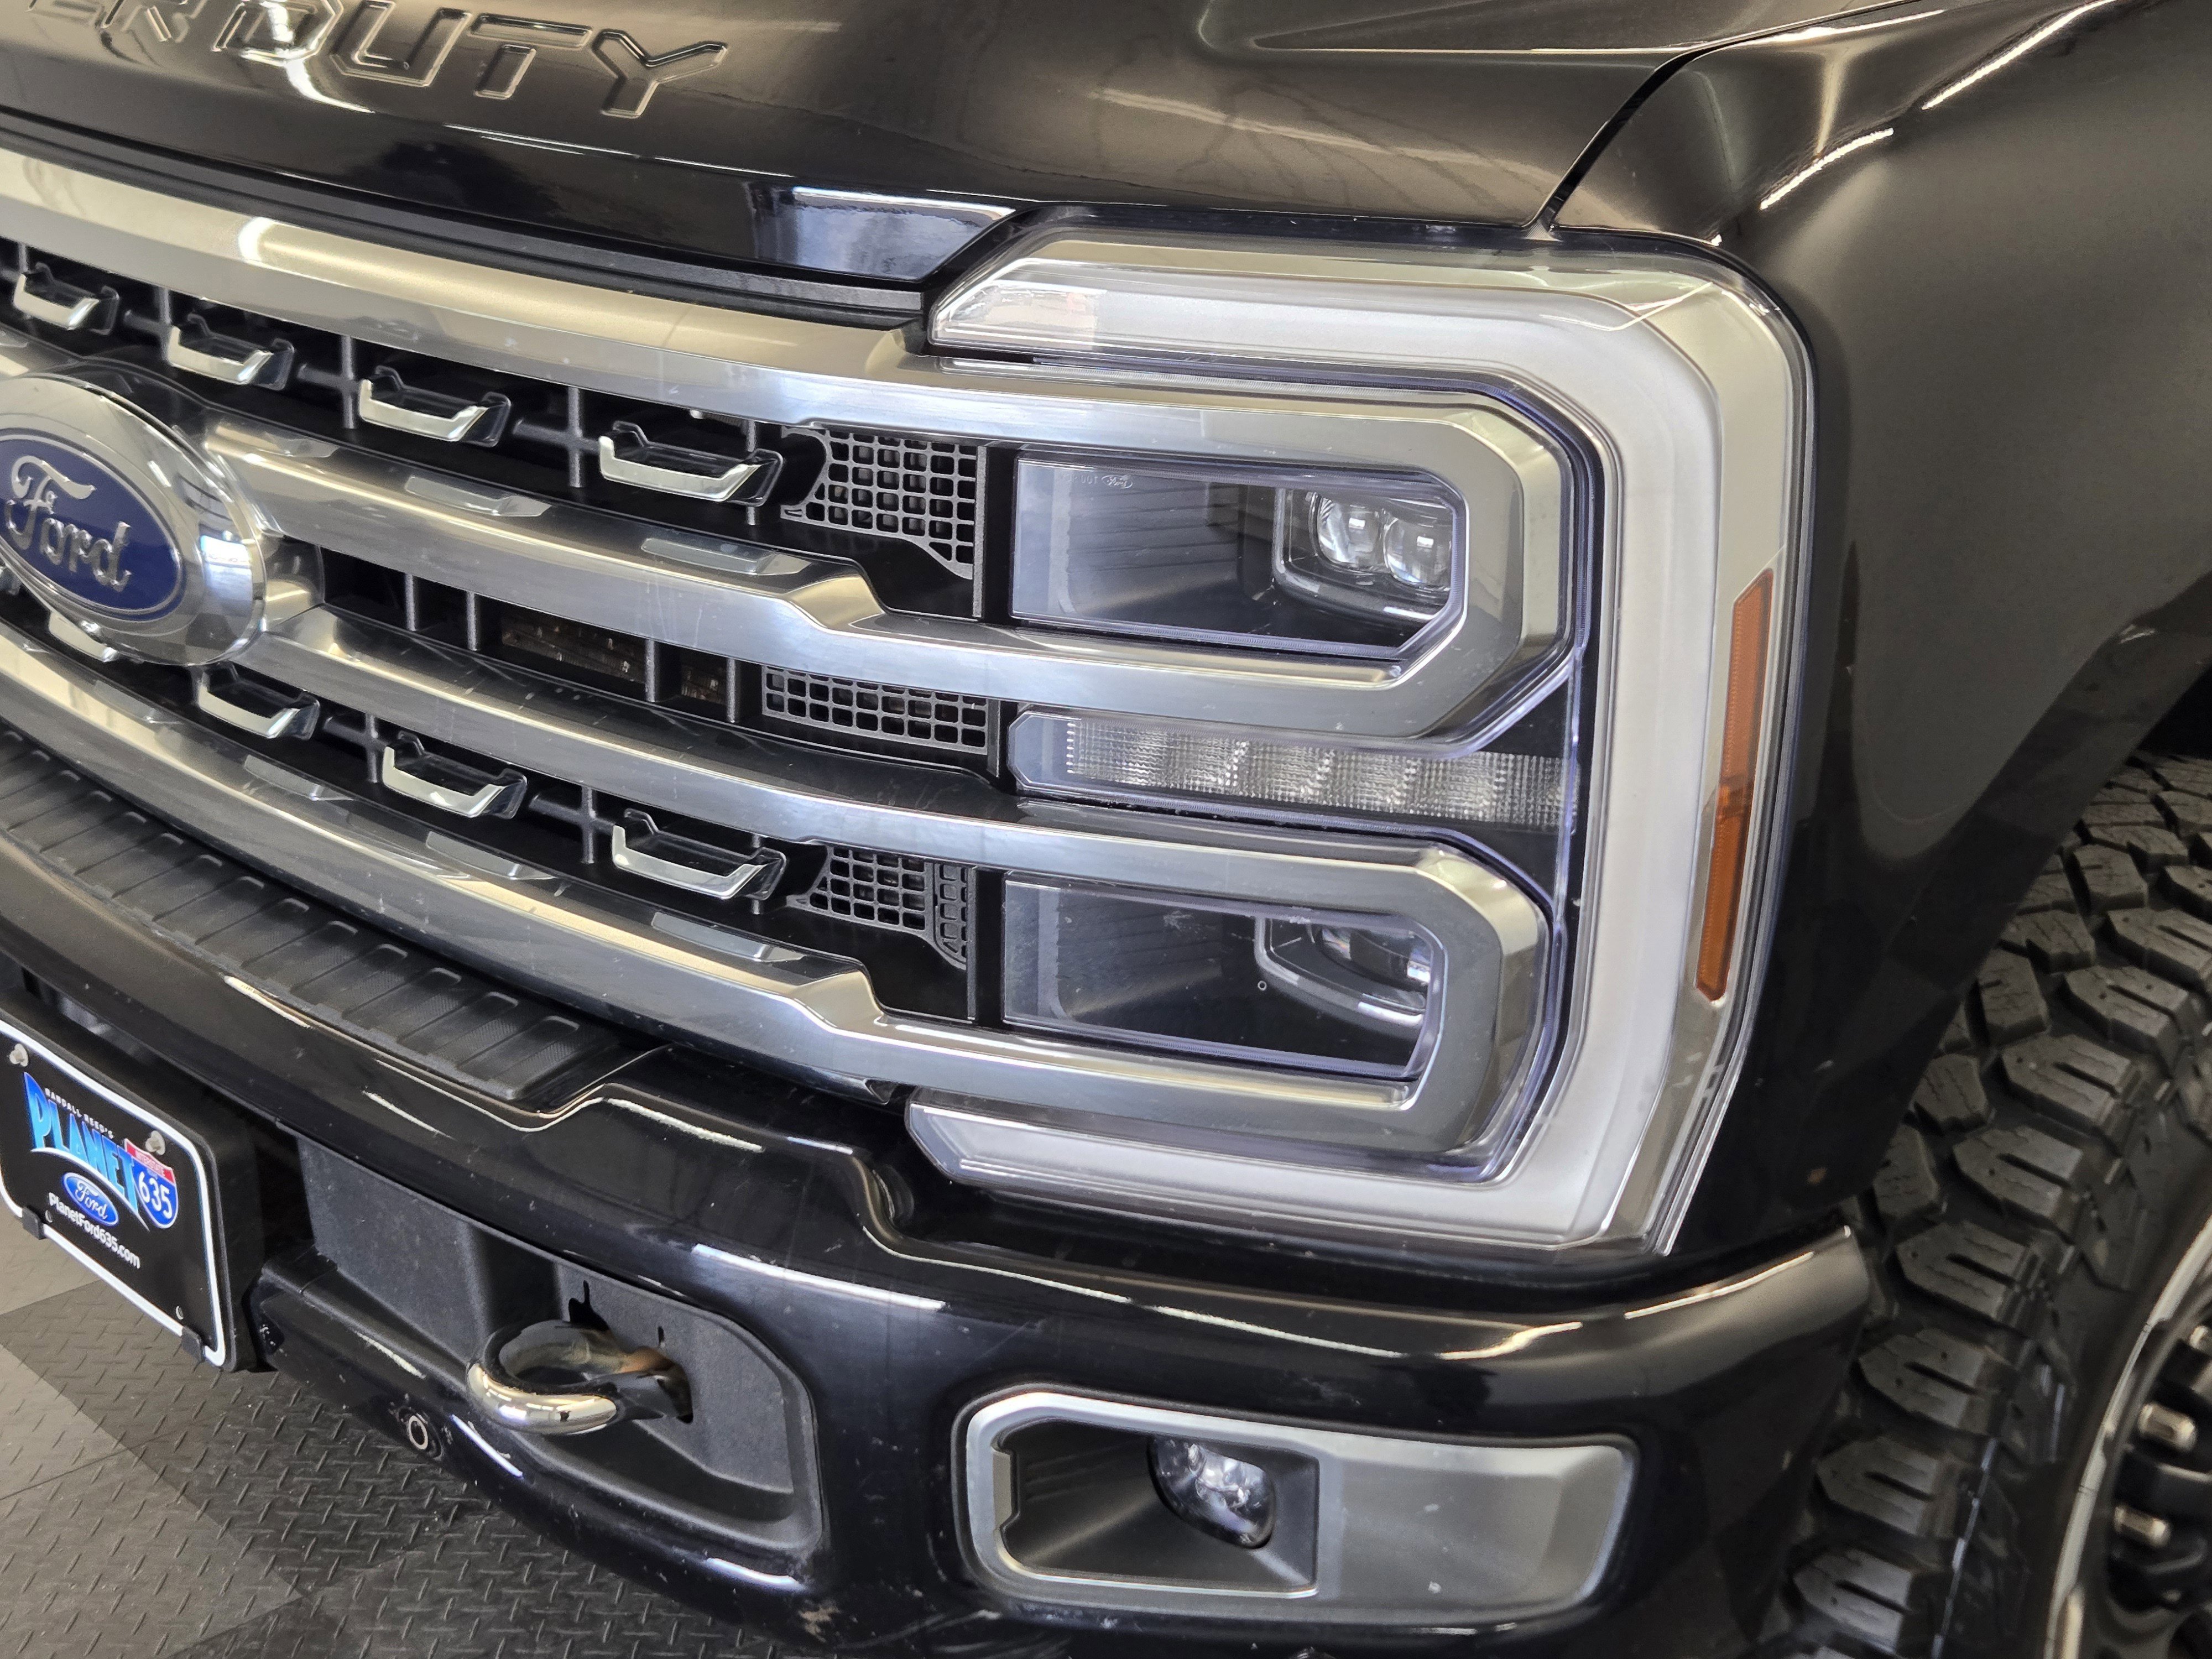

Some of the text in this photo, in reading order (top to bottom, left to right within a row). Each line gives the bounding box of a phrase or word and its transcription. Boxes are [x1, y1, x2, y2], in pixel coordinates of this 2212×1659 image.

[211, 0, 728, 118] DUTY
[5, 455, 132, 592] Ford
[24, 1071, 138, 1213] PLANET
[75, 1180, 108, 1219] Ford
[139, 1171, 173, 1219] 635
